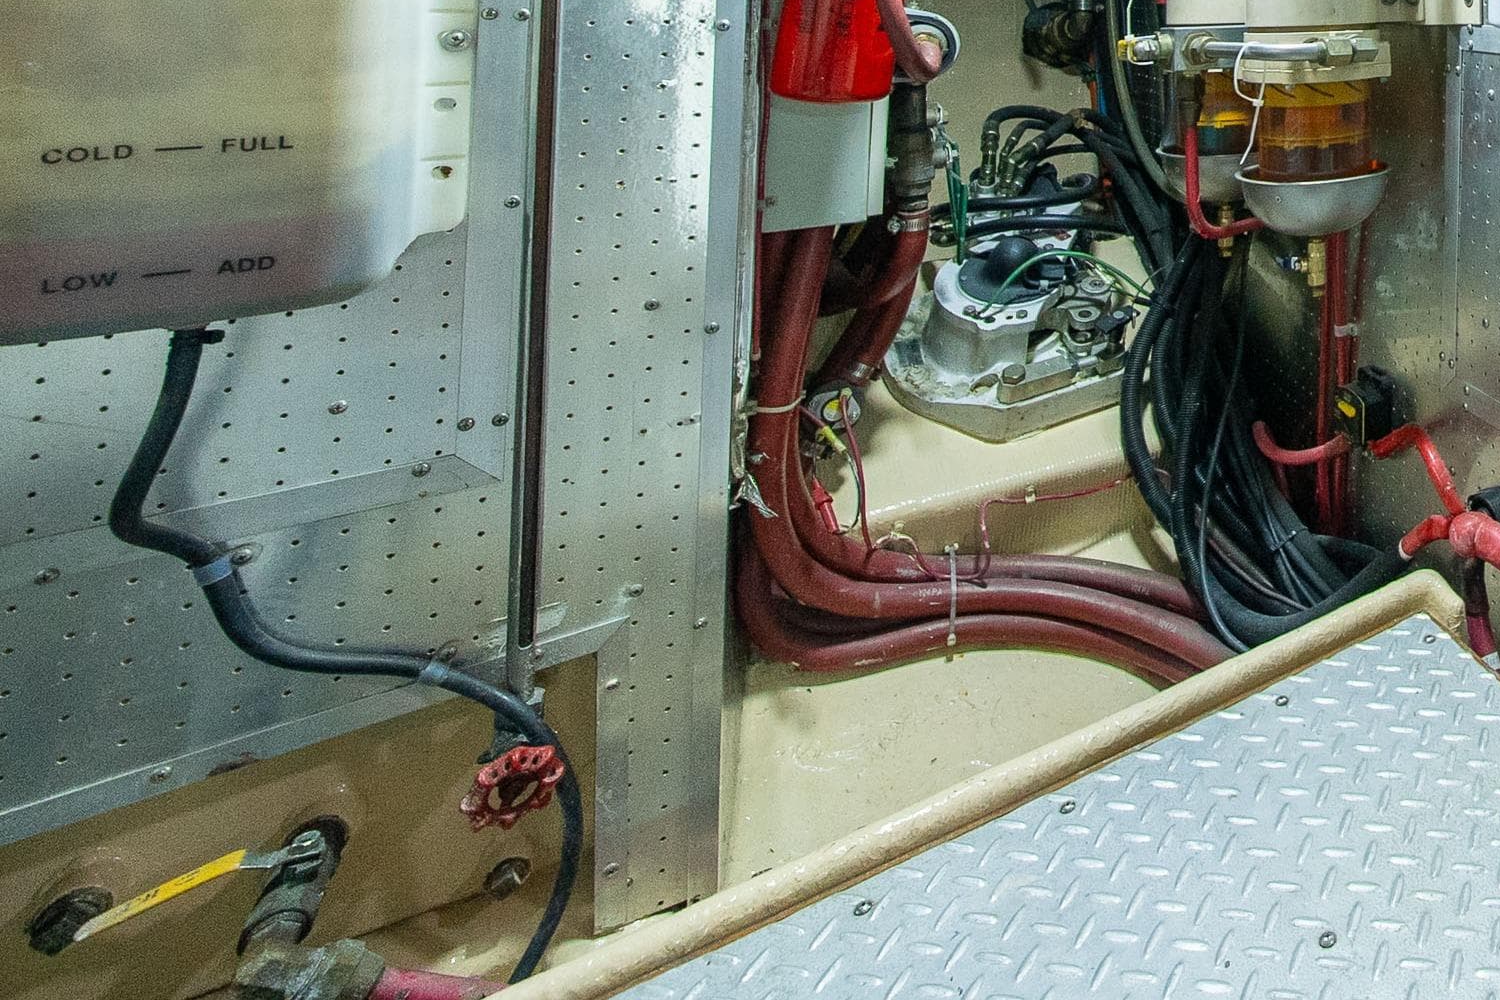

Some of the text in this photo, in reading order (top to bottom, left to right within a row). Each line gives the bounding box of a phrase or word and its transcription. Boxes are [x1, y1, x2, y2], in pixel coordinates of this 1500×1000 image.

[41, 135, 294, 165] COLD FULL
[41, 254, 276, 296] LOW ADD
